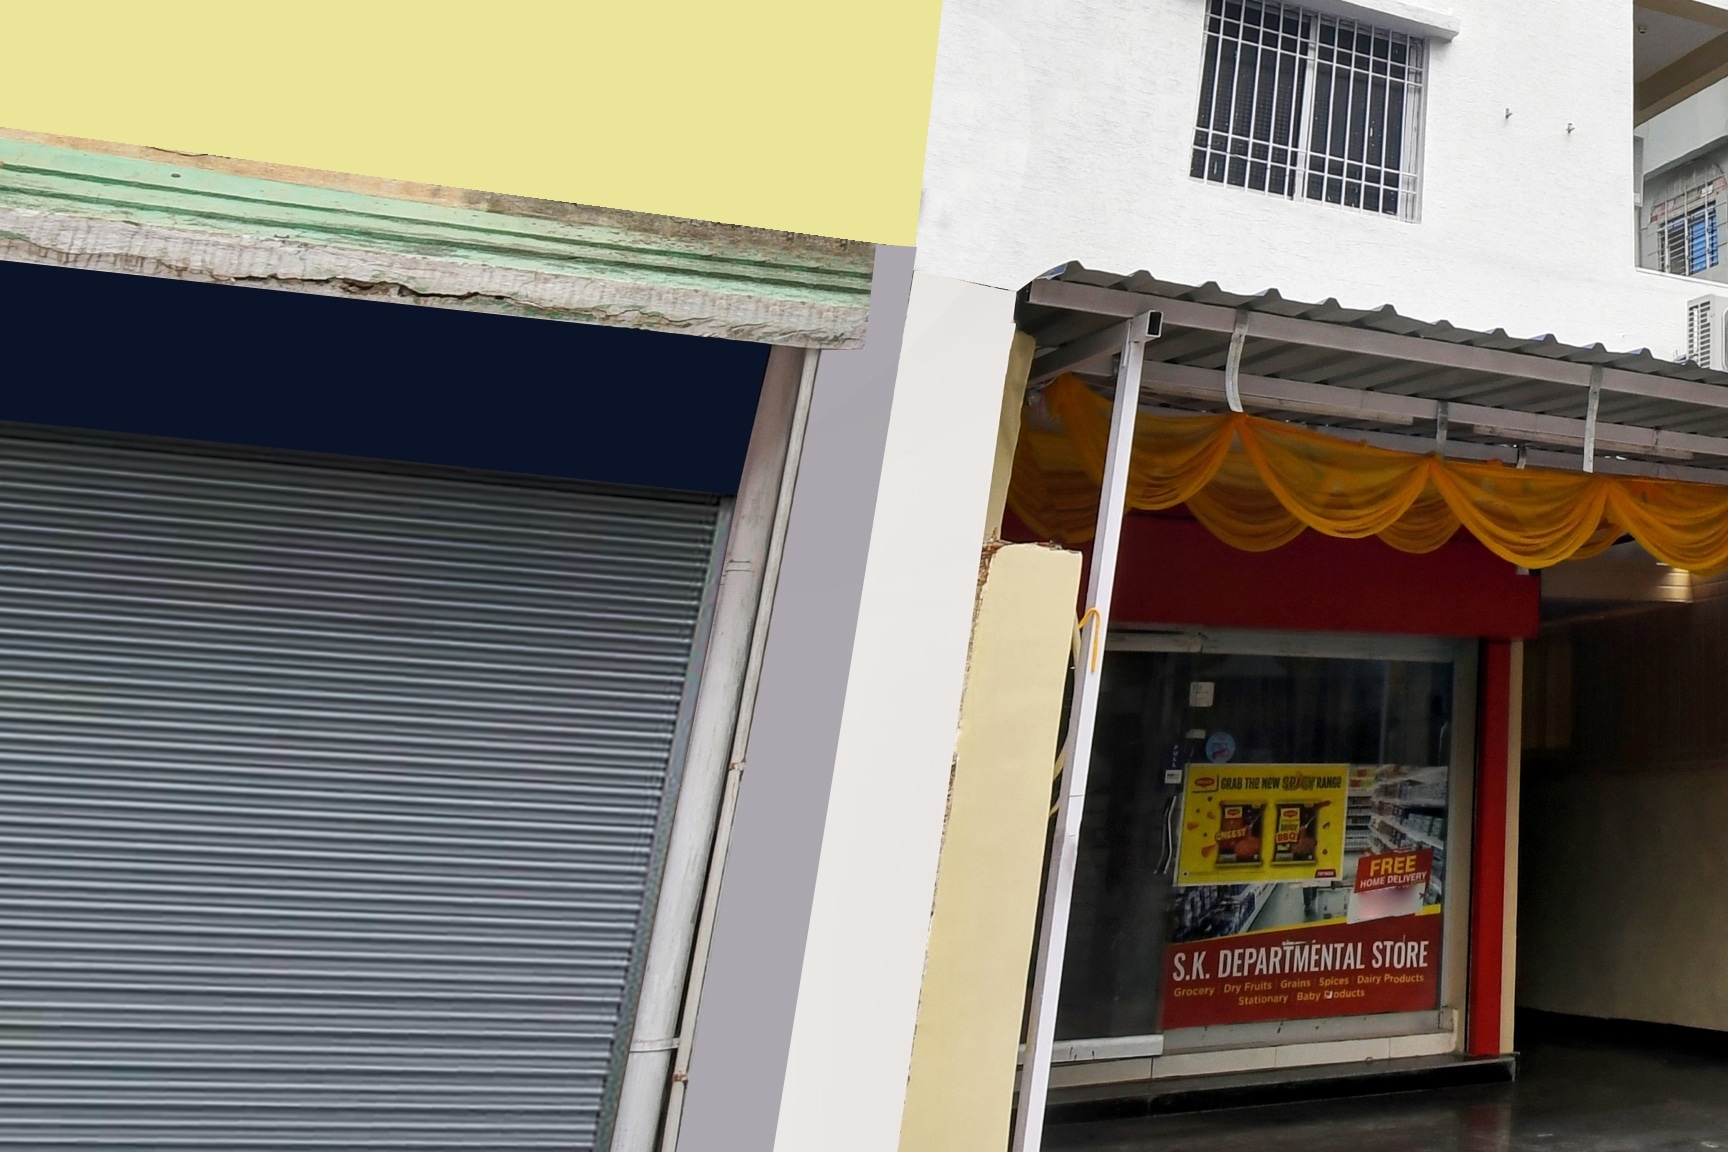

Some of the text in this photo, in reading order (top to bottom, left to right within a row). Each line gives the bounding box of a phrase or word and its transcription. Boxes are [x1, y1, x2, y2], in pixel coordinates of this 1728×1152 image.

[1222, 777, 1243, 790] GRAB
[1277, 832, 1297, 842] BBQ
[1369, 854, 1417, 877] FREE
[1360, 871, 1428, 888] HOME DELIVERY
[1172, 940, 1430, 982] S.K. DEPARTMENTAL STORE
[1174, 973, 1425, 998] Grocery Dry Fruits Grains Spices Dairy Products
[1238, 989, 1365, 1006] Stationary Baby Poducts
